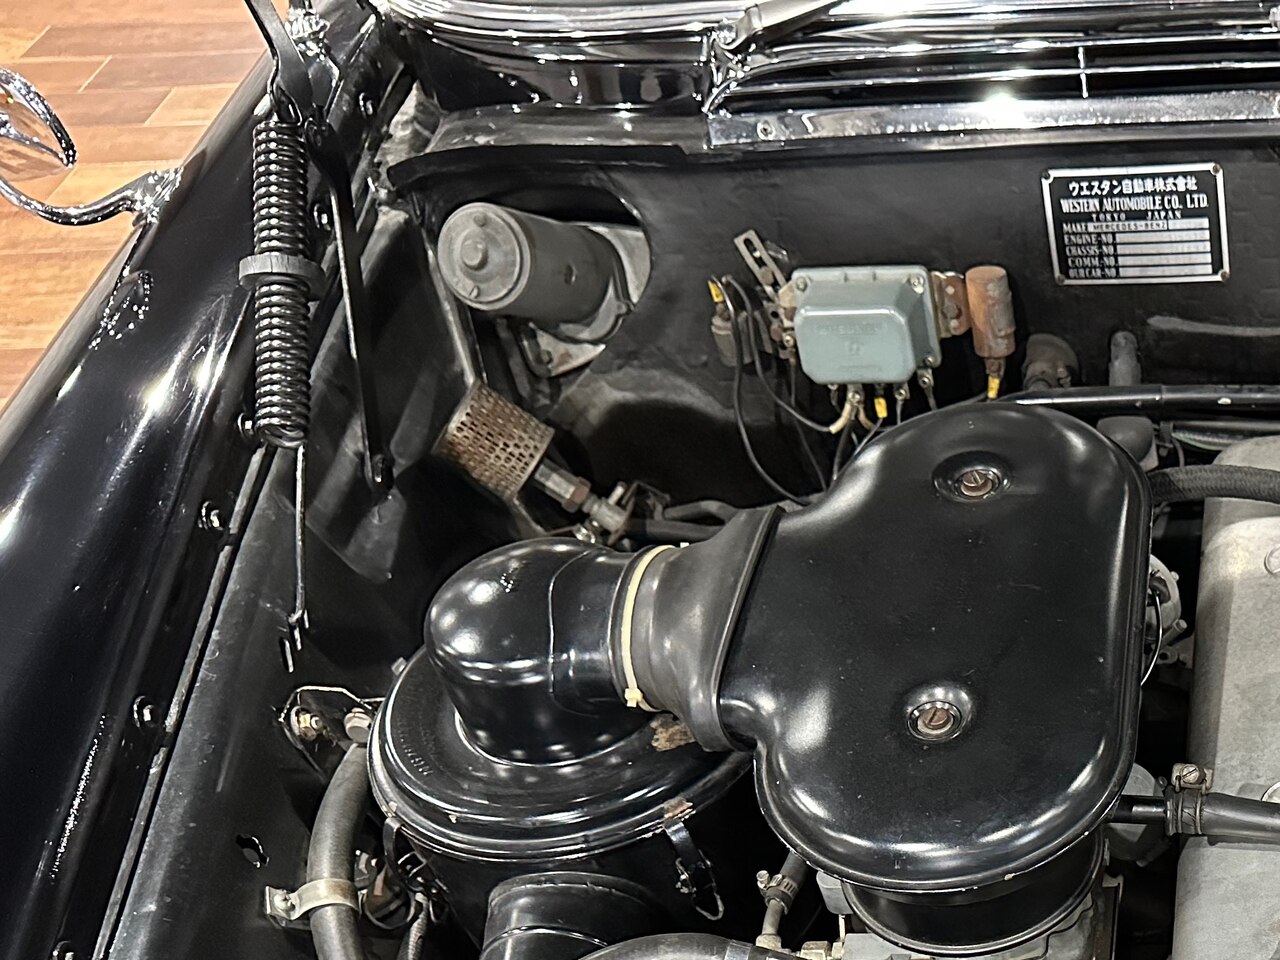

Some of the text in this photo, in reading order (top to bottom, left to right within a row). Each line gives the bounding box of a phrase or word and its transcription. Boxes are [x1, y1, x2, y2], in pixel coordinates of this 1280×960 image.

[1060, 198, 1100, 213] WESTERN
[1102, 195, 1162, 212] AUTOMOBILE
[1091, 210, 1182, 222] TOKYO JAPAN
[1062, 221, 1166, 233] MAKE MERCEDES-BENZ
